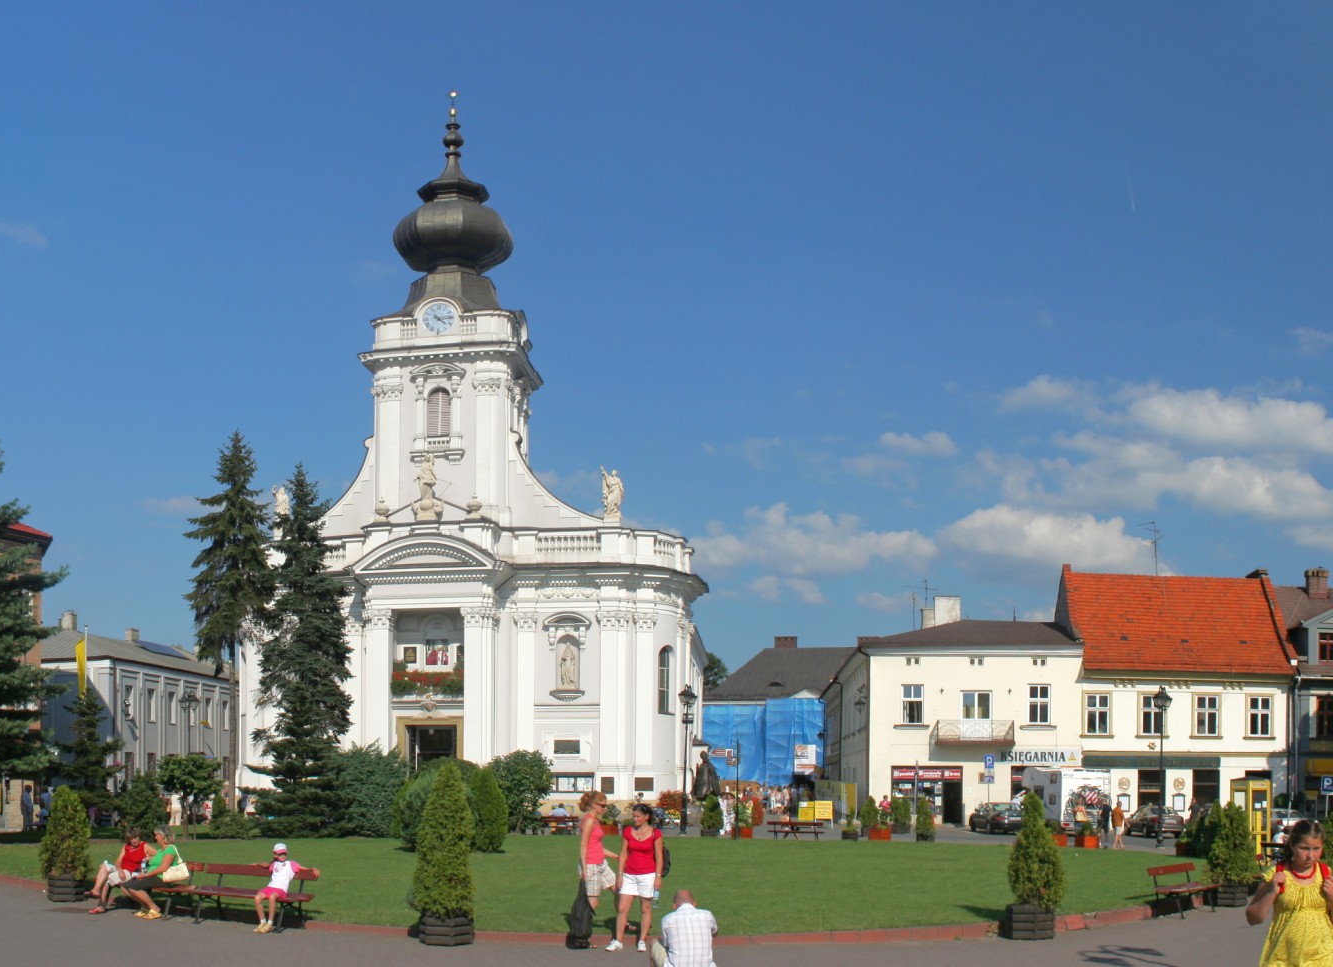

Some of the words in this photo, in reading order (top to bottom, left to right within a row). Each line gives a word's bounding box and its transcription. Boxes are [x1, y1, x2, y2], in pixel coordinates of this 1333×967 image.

[986, 756, 994, 767] P
[1000, 751, 1066, 763] KSIĘGARNIA
[1324, 778, 1332, 789] P
